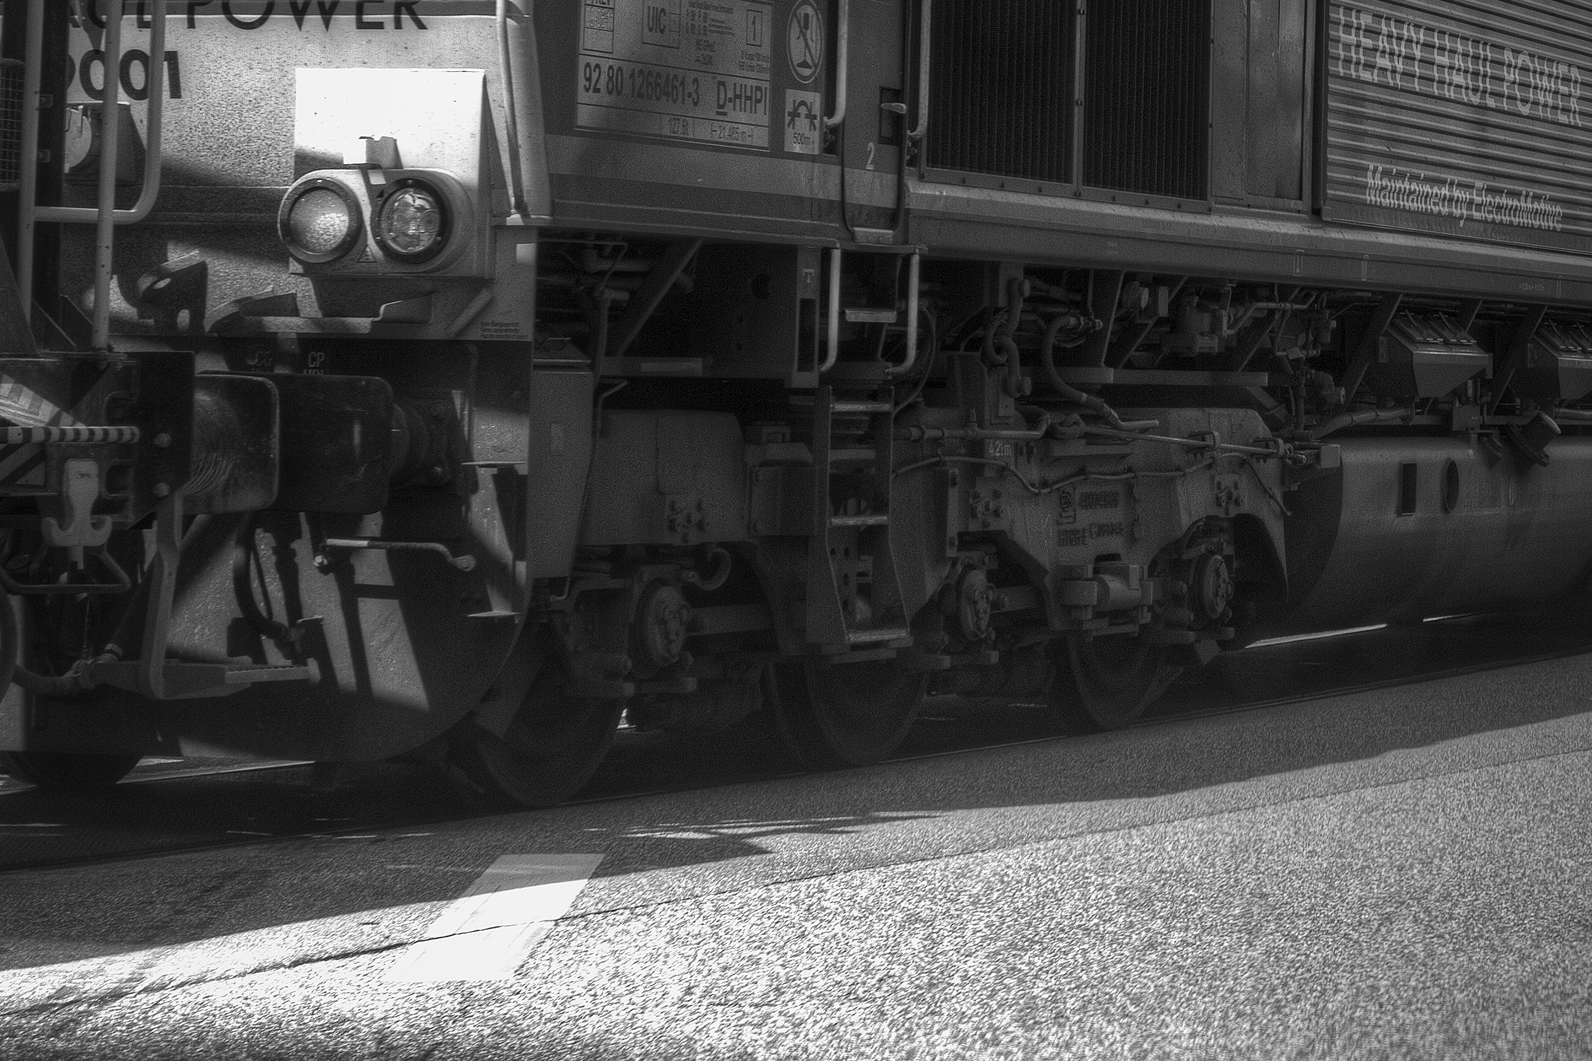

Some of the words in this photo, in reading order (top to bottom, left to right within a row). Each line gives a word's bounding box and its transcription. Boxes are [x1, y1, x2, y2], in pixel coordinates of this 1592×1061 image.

[647, 5, 667, 35] UIC
[1338, 5, 1426, 92] HEAVY
[1433, 28, 1496, 109] HAUL
[1503, 46, 1582, 128] POWER
[583, 62, 601, 94] 92
[607, 65, 624, 97] 80
[629, 67, 700, 108] 1266461-3
[716, 80, 767, 116] D-HHPI
[866, 142, 875, 171] 2
[1366, 164, 1450, 217] Maintained
[1453, 178, 1469, 228] by
[1472, 180, 1563, 232] ElectroMotive
[308, 351, 326, 369] CP
